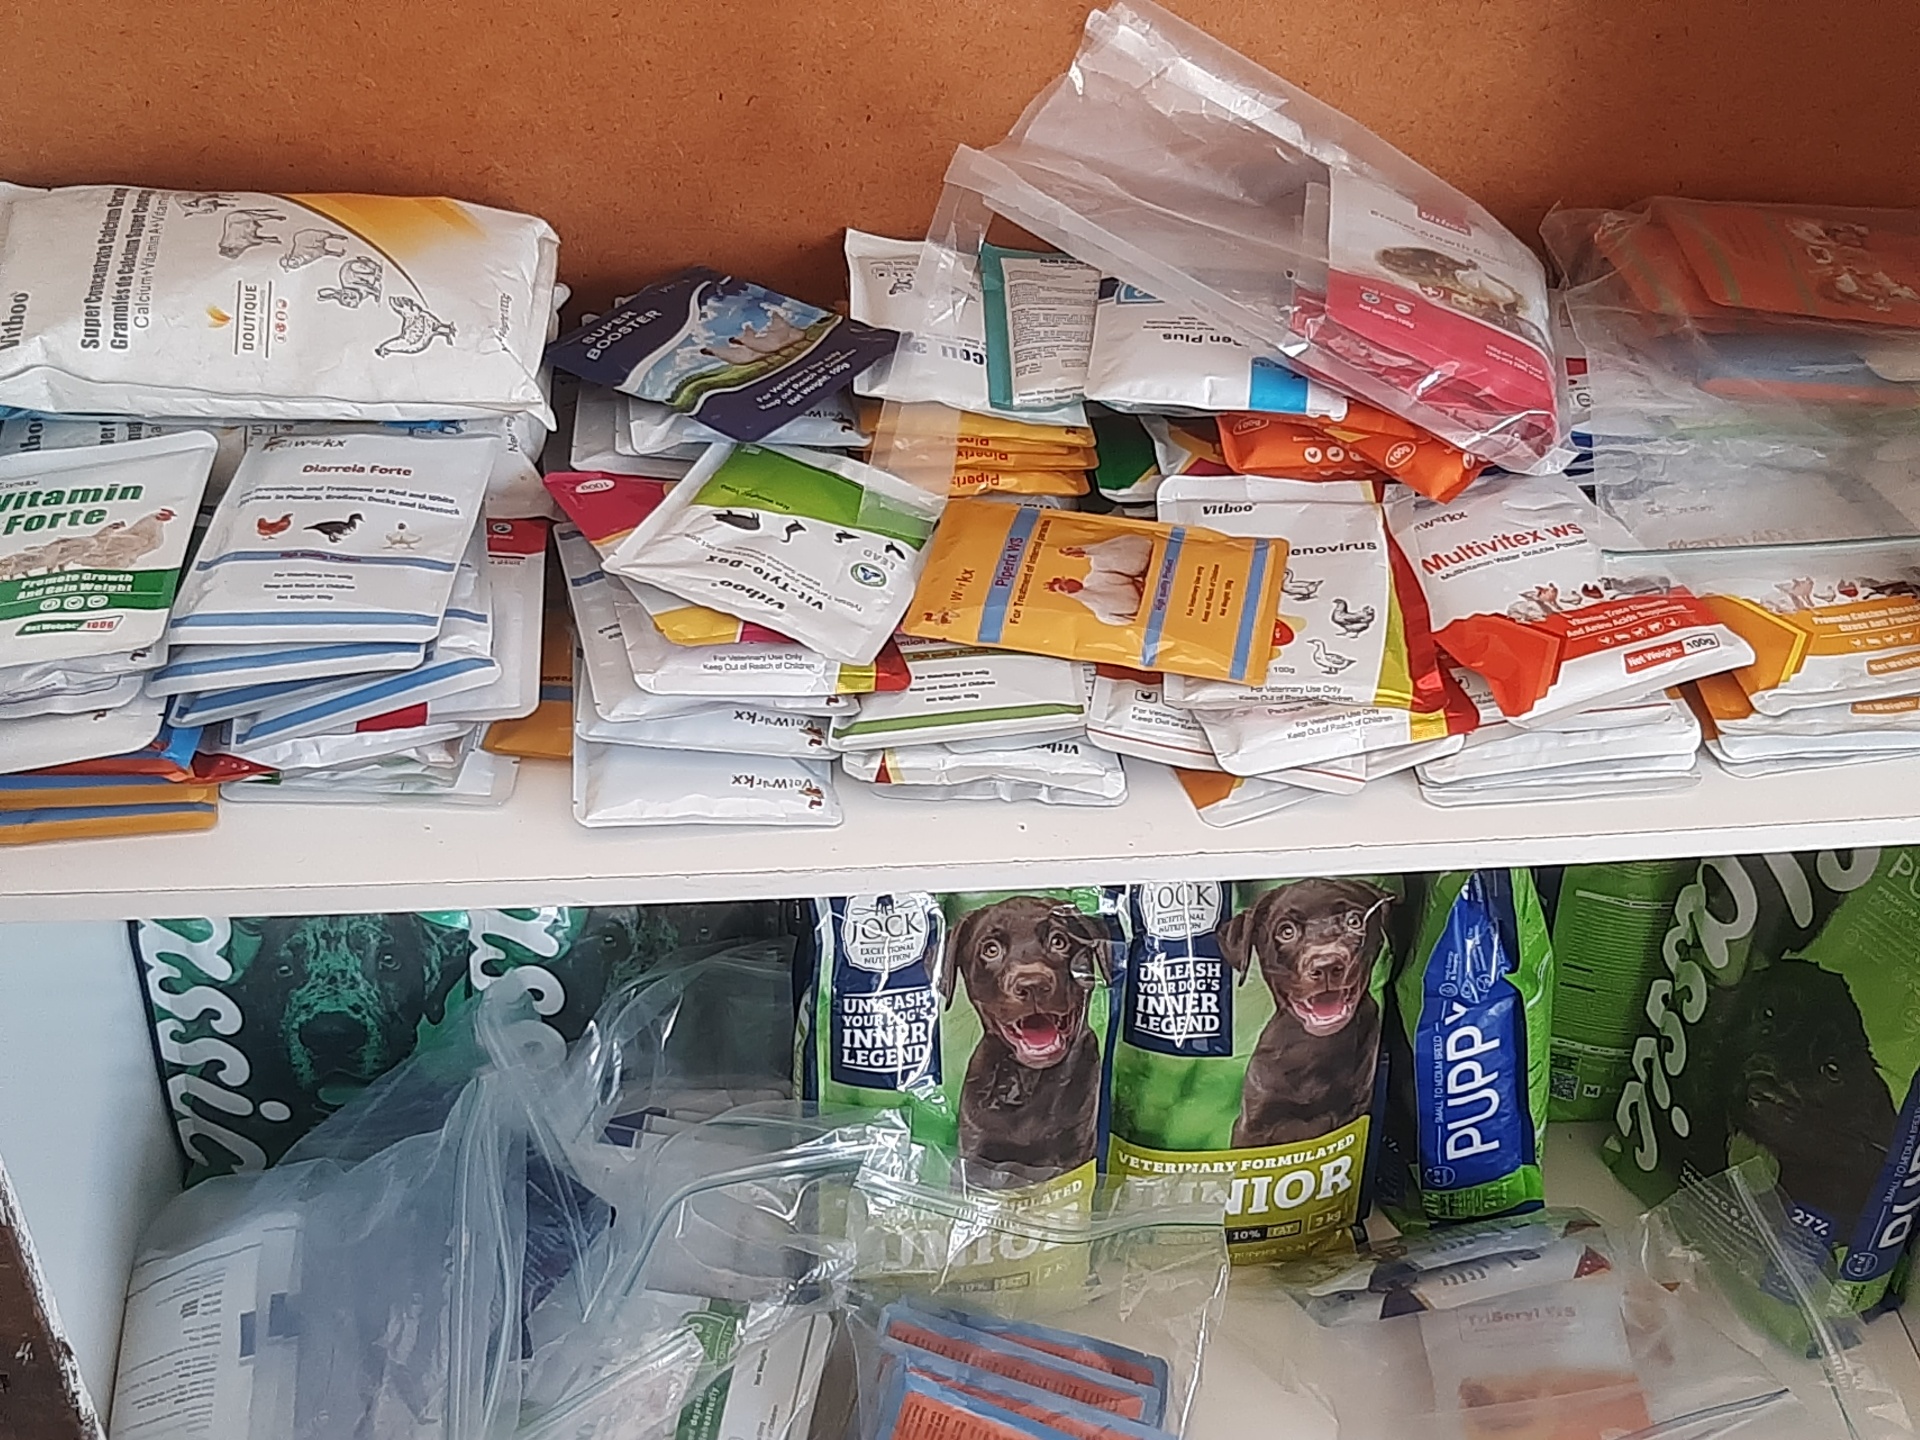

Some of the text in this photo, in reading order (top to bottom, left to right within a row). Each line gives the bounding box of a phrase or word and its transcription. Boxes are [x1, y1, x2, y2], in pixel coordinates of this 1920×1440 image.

[81, 303, 101, 349] Super
[581, 310, 638, 345] SUPER
[587, 309, 662, 361] BOOSTER
[1162, 333, 1203, 344] Plus
[370, 465, 412, 476] Forte
[2, 508, 107, 535] Forte
[863, 549, 896, 570] LEAD
[1288, 541, 1378, 557] enovirus
[1421, 529, 1546, 575] Multivitex
[17, 588, 43, 600] And
[80, 583, 132, 593] Weight
[1010, 609, 1021, 625] For
[1566, 627, 1585, 638] And
[1627, 655, 1647, 667] Net
[1686, 637, 1717, 649] 100g
[703, 663, 723, 672] Keep
[1131, 714, 1153, 722] Keep
[851, 912, 925, 948] JOCK
[1135, 992, 1220, 1014] INNER
[1134, 1014, 1220, 1034] LEGEND
[842, 1044, 928, 1067] LEGEND
[1445, 1001, 1500, 1160] PUPPY
[1117, 1134, 1356, 1174] VETERINARY FORMULATED
[1790, 1207, 1830, 1238] 27%
[1232, 1228, 1261, 1240] 10%
